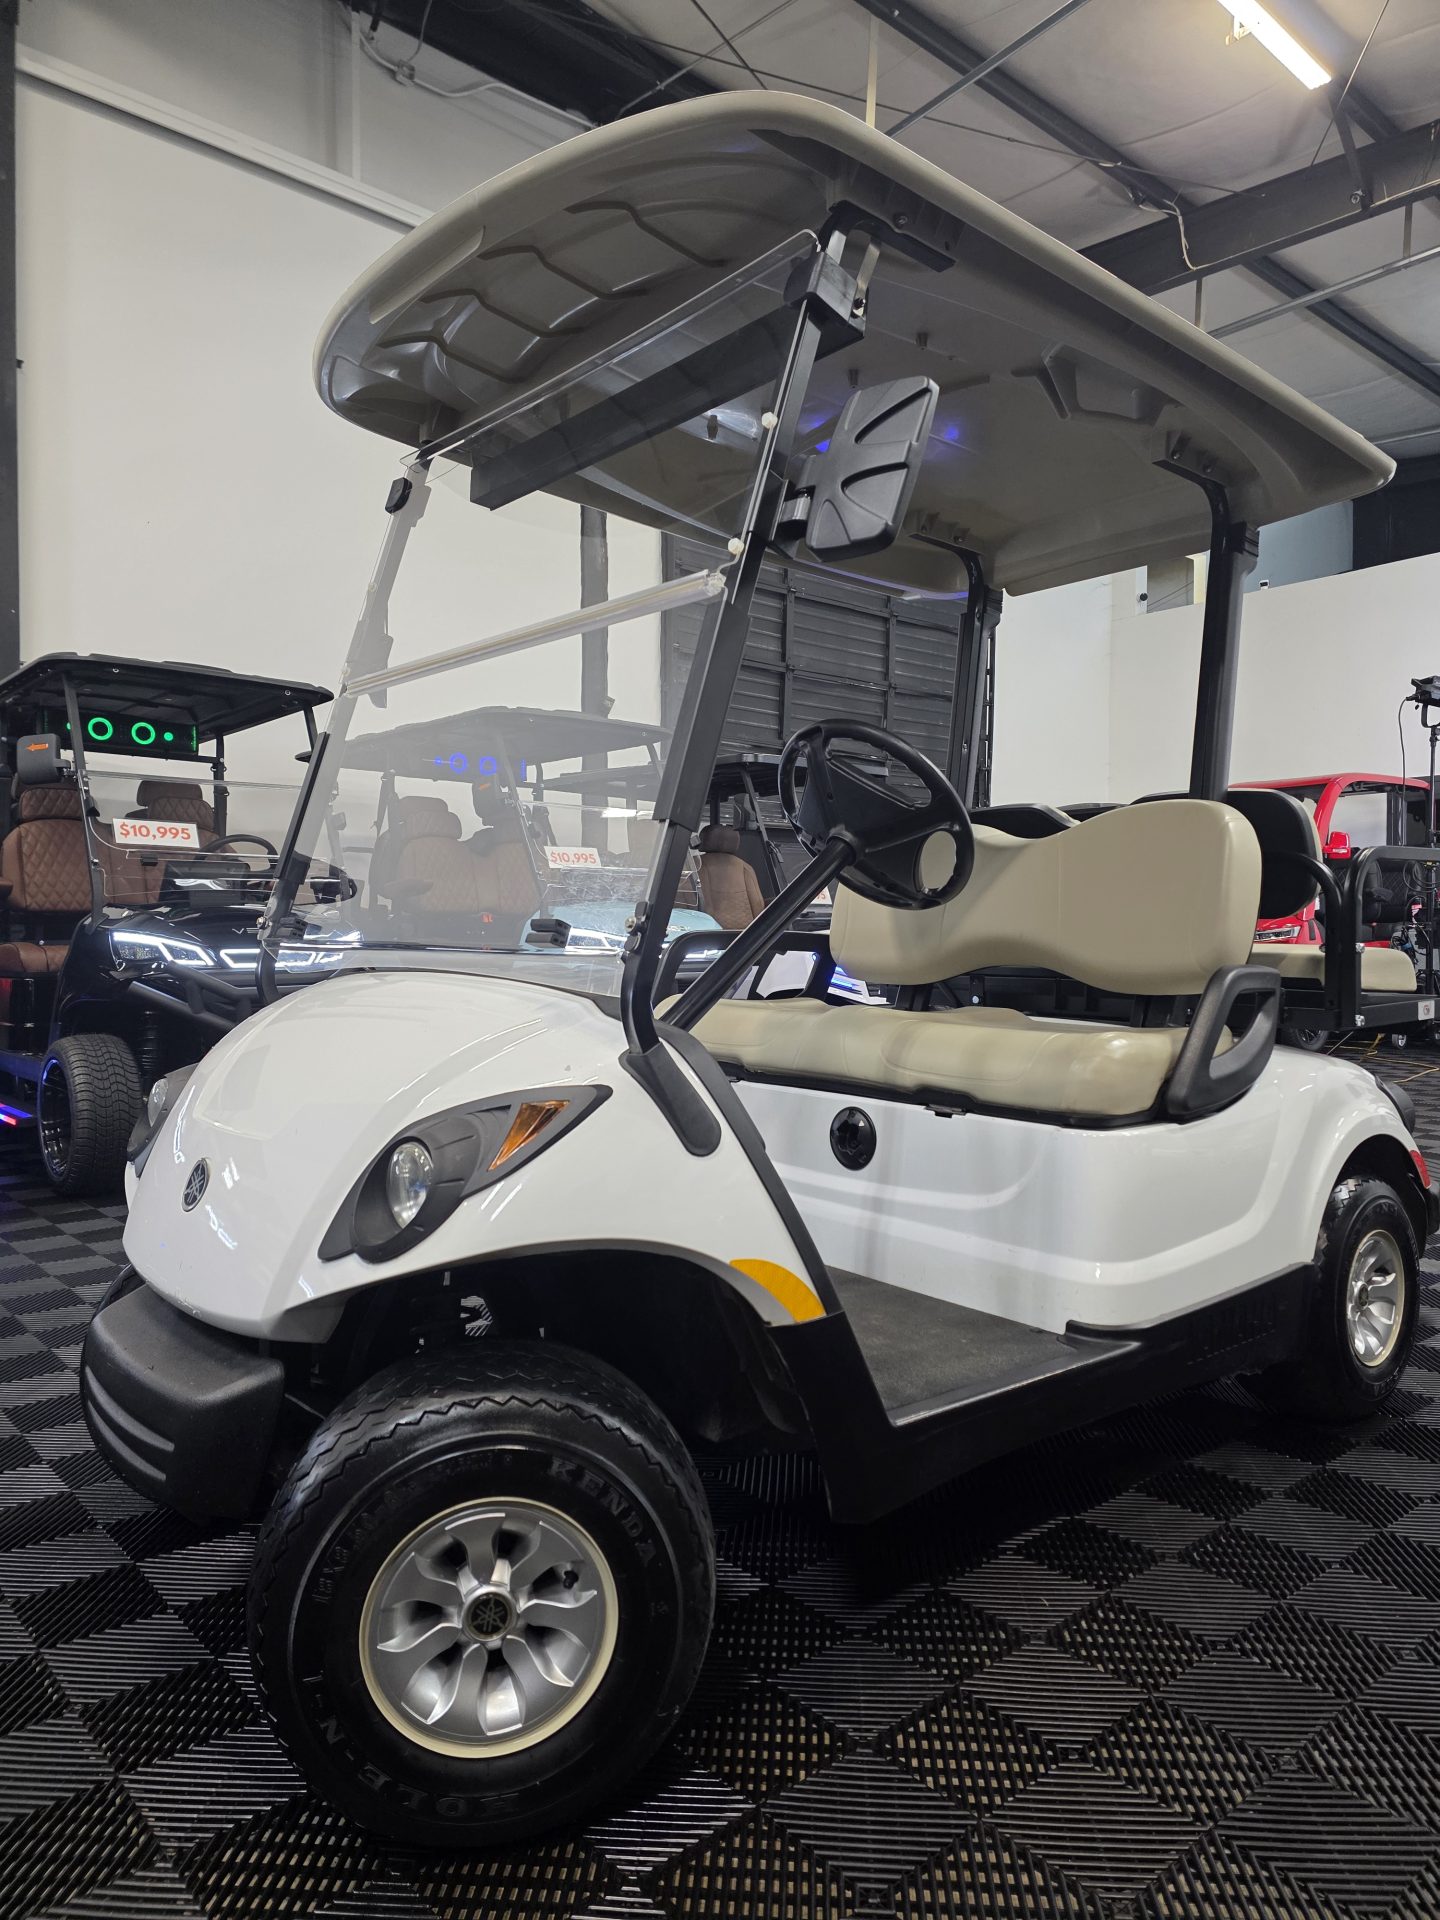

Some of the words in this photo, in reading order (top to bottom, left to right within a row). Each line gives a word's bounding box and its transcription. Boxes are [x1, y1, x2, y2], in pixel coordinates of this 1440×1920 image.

[120, 822, 191, 840] $10,995
[550, 850, 597, 864] $10,995
[548, 1457, 657, 1567] KENDA
